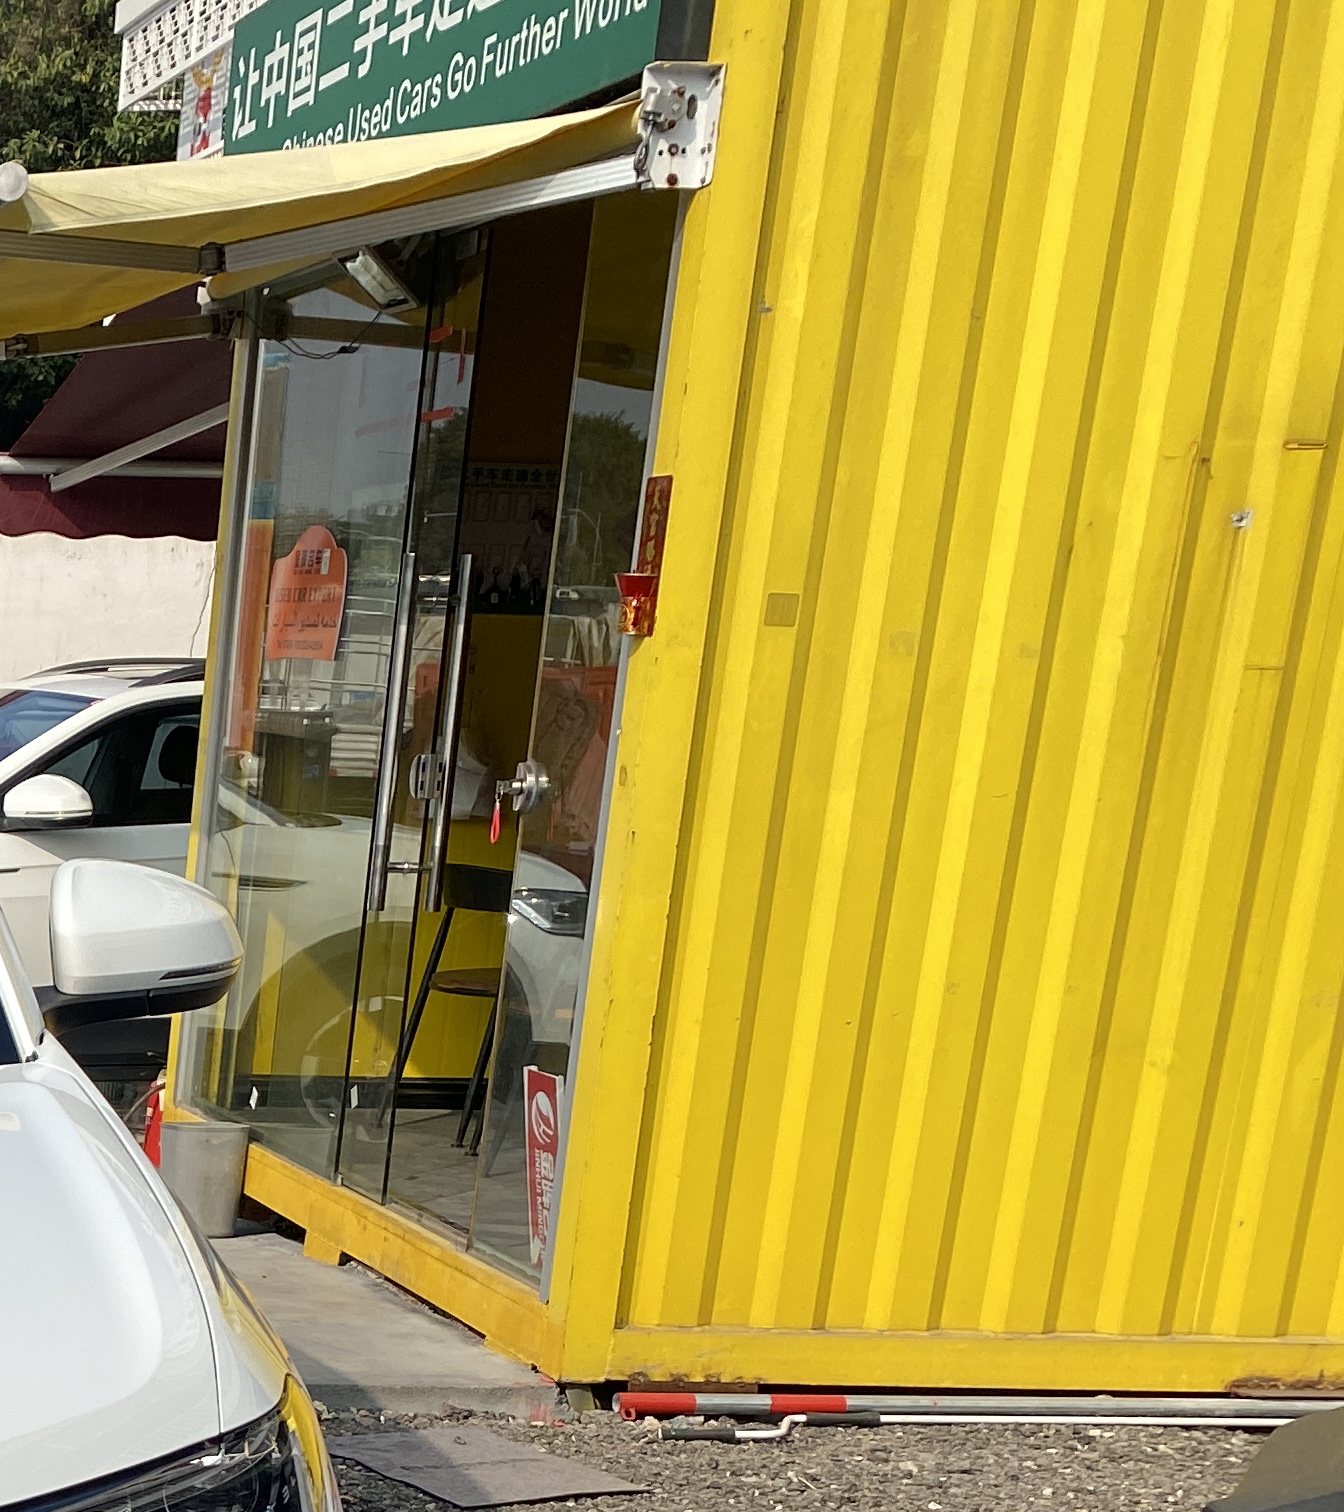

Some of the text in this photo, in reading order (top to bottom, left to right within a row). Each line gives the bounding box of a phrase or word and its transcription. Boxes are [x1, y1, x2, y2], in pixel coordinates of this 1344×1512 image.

[348, 86, 395, 143] Used
[396, 73, 443, 125] Cars
[446, 52, 477, 100] Go
[480, 8, 569, 86] Further
[574, 0, 647, 39] Wor
